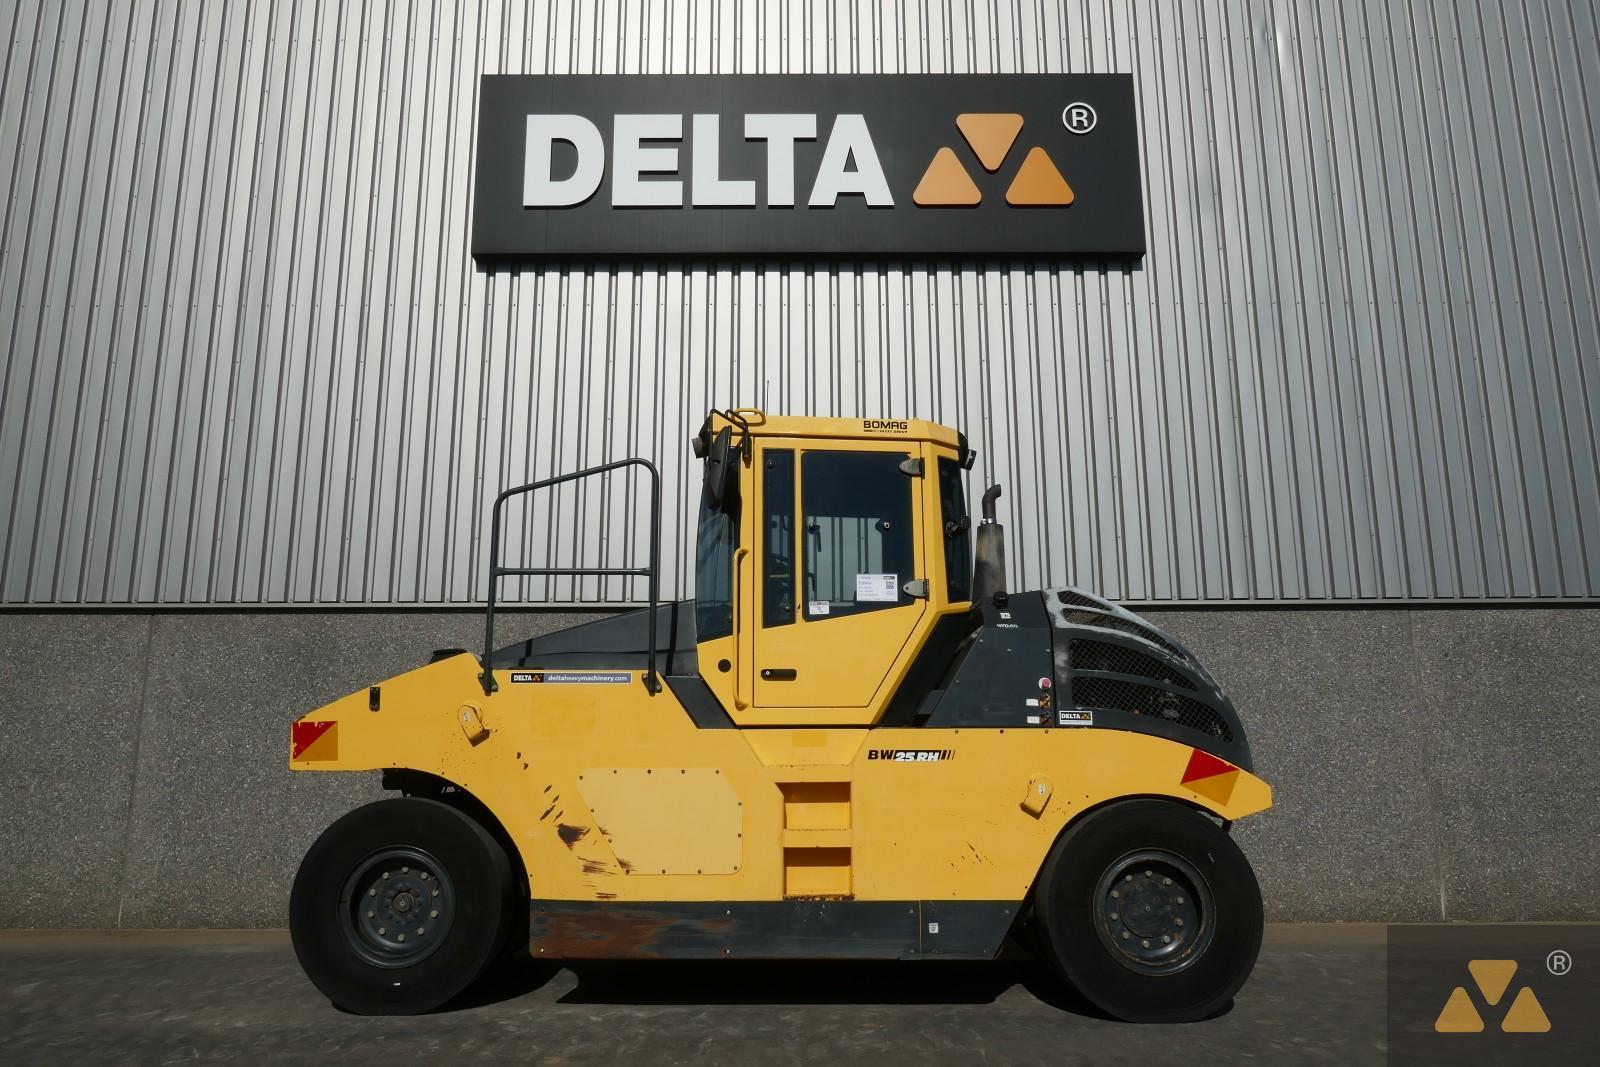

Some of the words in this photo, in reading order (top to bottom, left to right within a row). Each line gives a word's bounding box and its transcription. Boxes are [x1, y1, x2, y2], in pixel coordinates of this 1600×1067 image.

[523, 113, 895, 208] DELTA
[863, 420, 908, 430] BOMAG
[548, 674, 627, 682] deltaheavymachinery.com
[867, 749, 894, 760] BW
